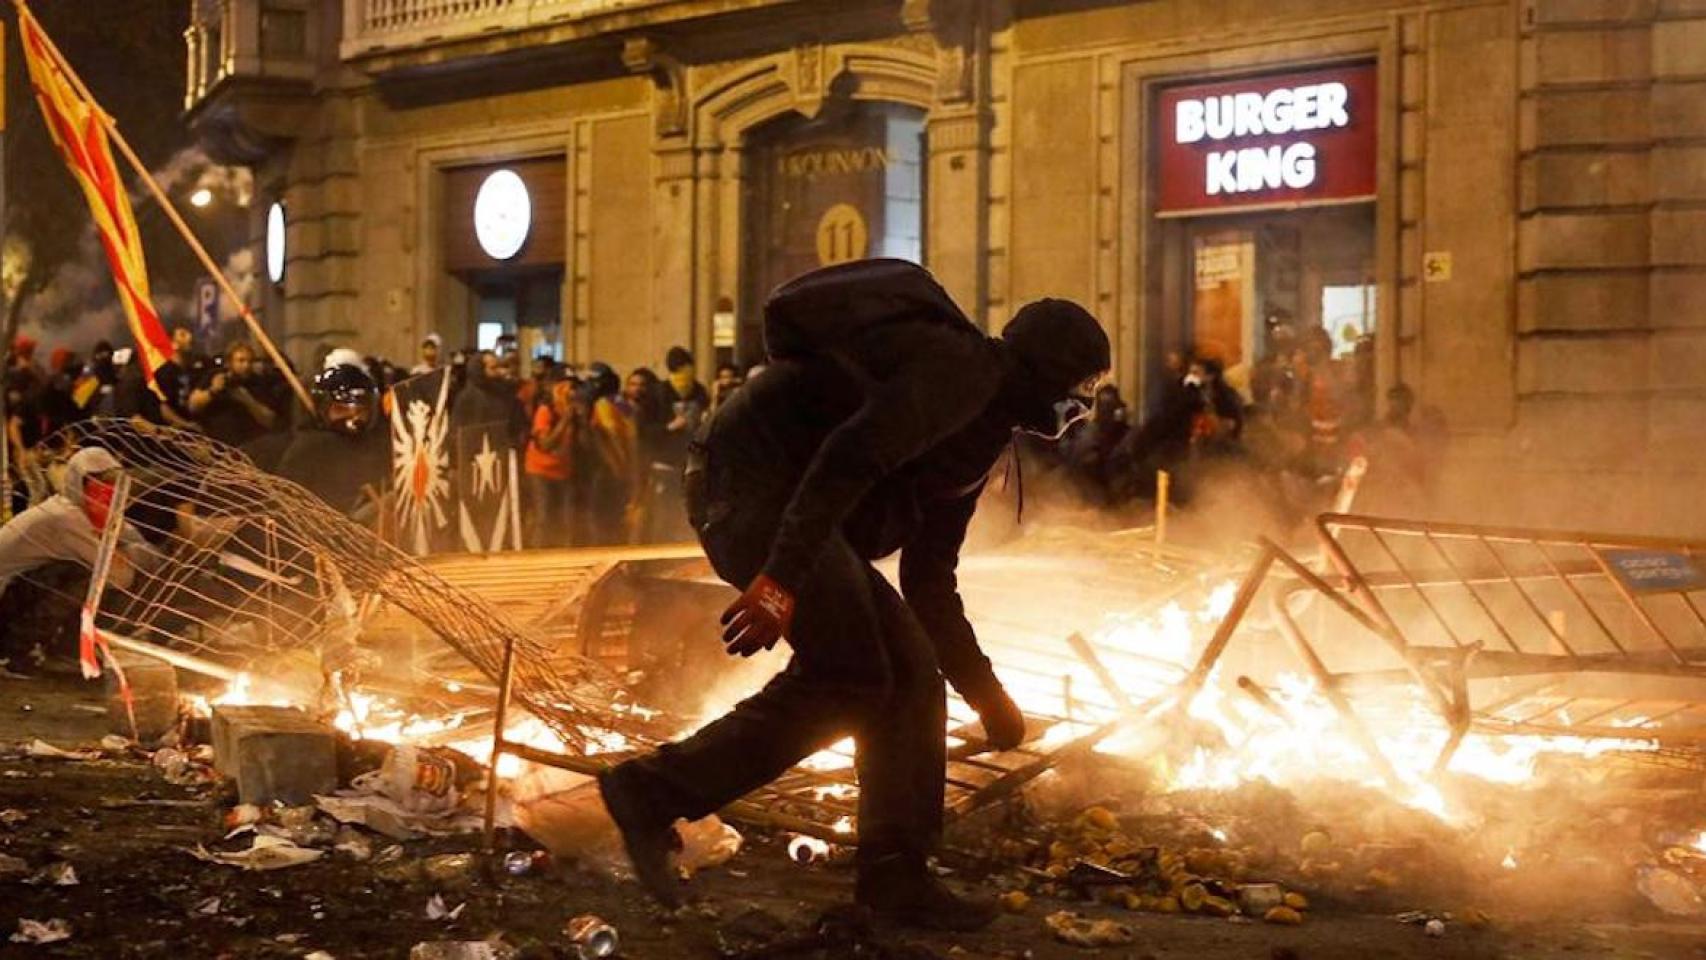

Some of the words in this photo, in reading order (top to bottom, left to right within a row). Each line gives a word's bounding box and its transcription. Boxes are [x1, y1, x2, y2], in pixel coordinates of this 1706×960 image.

[1176, 82, 1348, 143] BURGER
[1206, 142, 1315, 195] KING
[825, 221, 854, 259] 11
